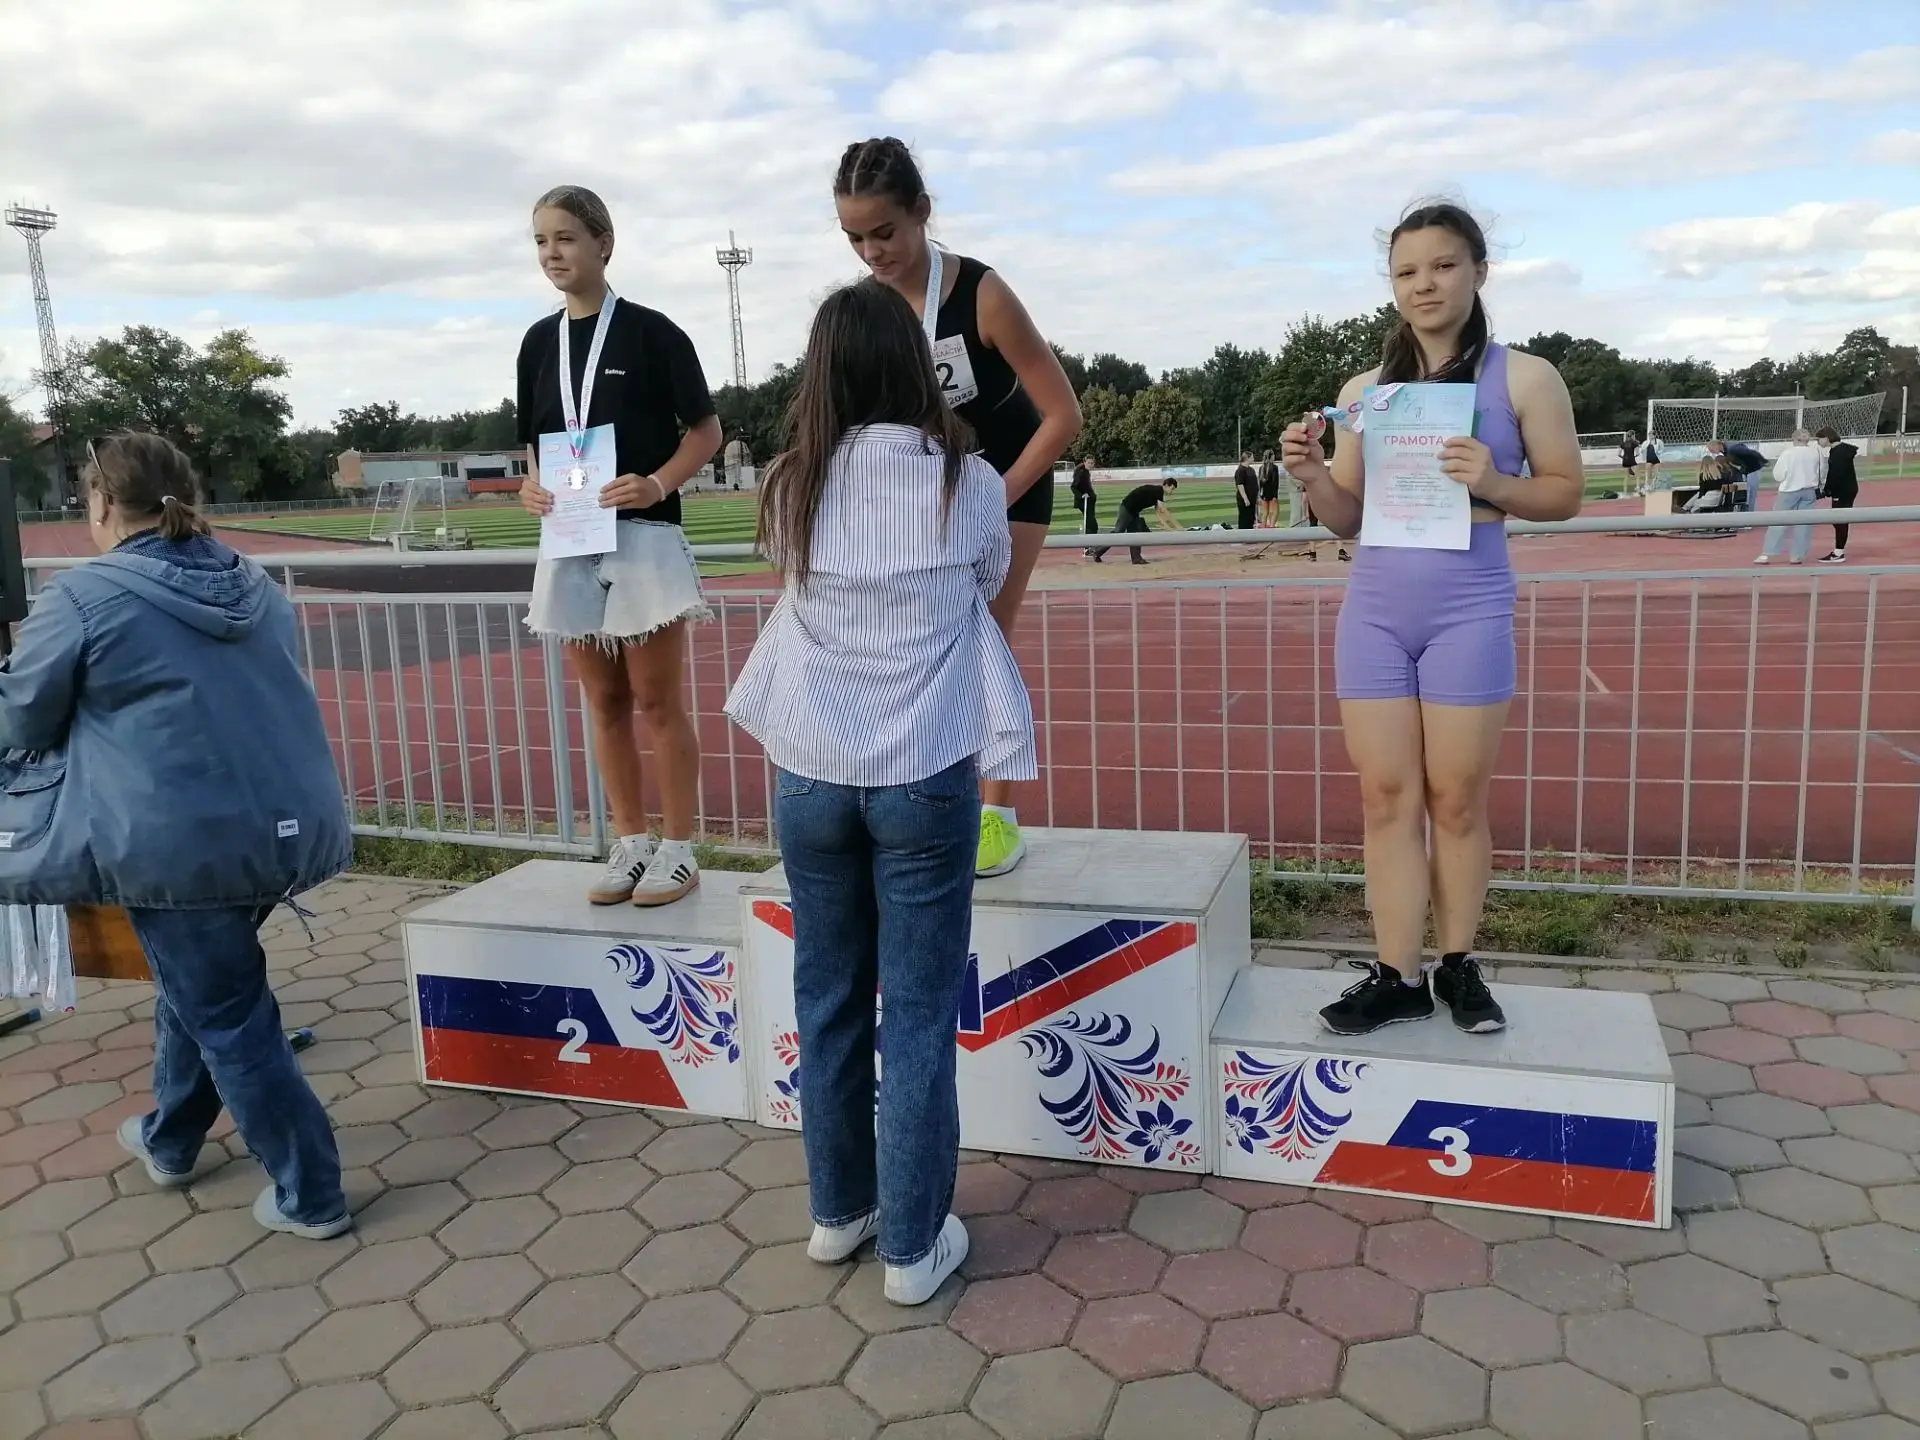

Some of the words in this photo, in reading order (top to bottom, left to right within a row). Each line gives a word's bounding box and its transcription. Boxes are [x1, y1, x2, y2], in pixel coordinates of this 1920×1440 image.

[936, 362, 959, 391] 2
[1384, 435, 1445, 446] ГРАМОТА
[557, 1018, 591, 1064] 2
[1427, 1126, 1472, 1176] 3
